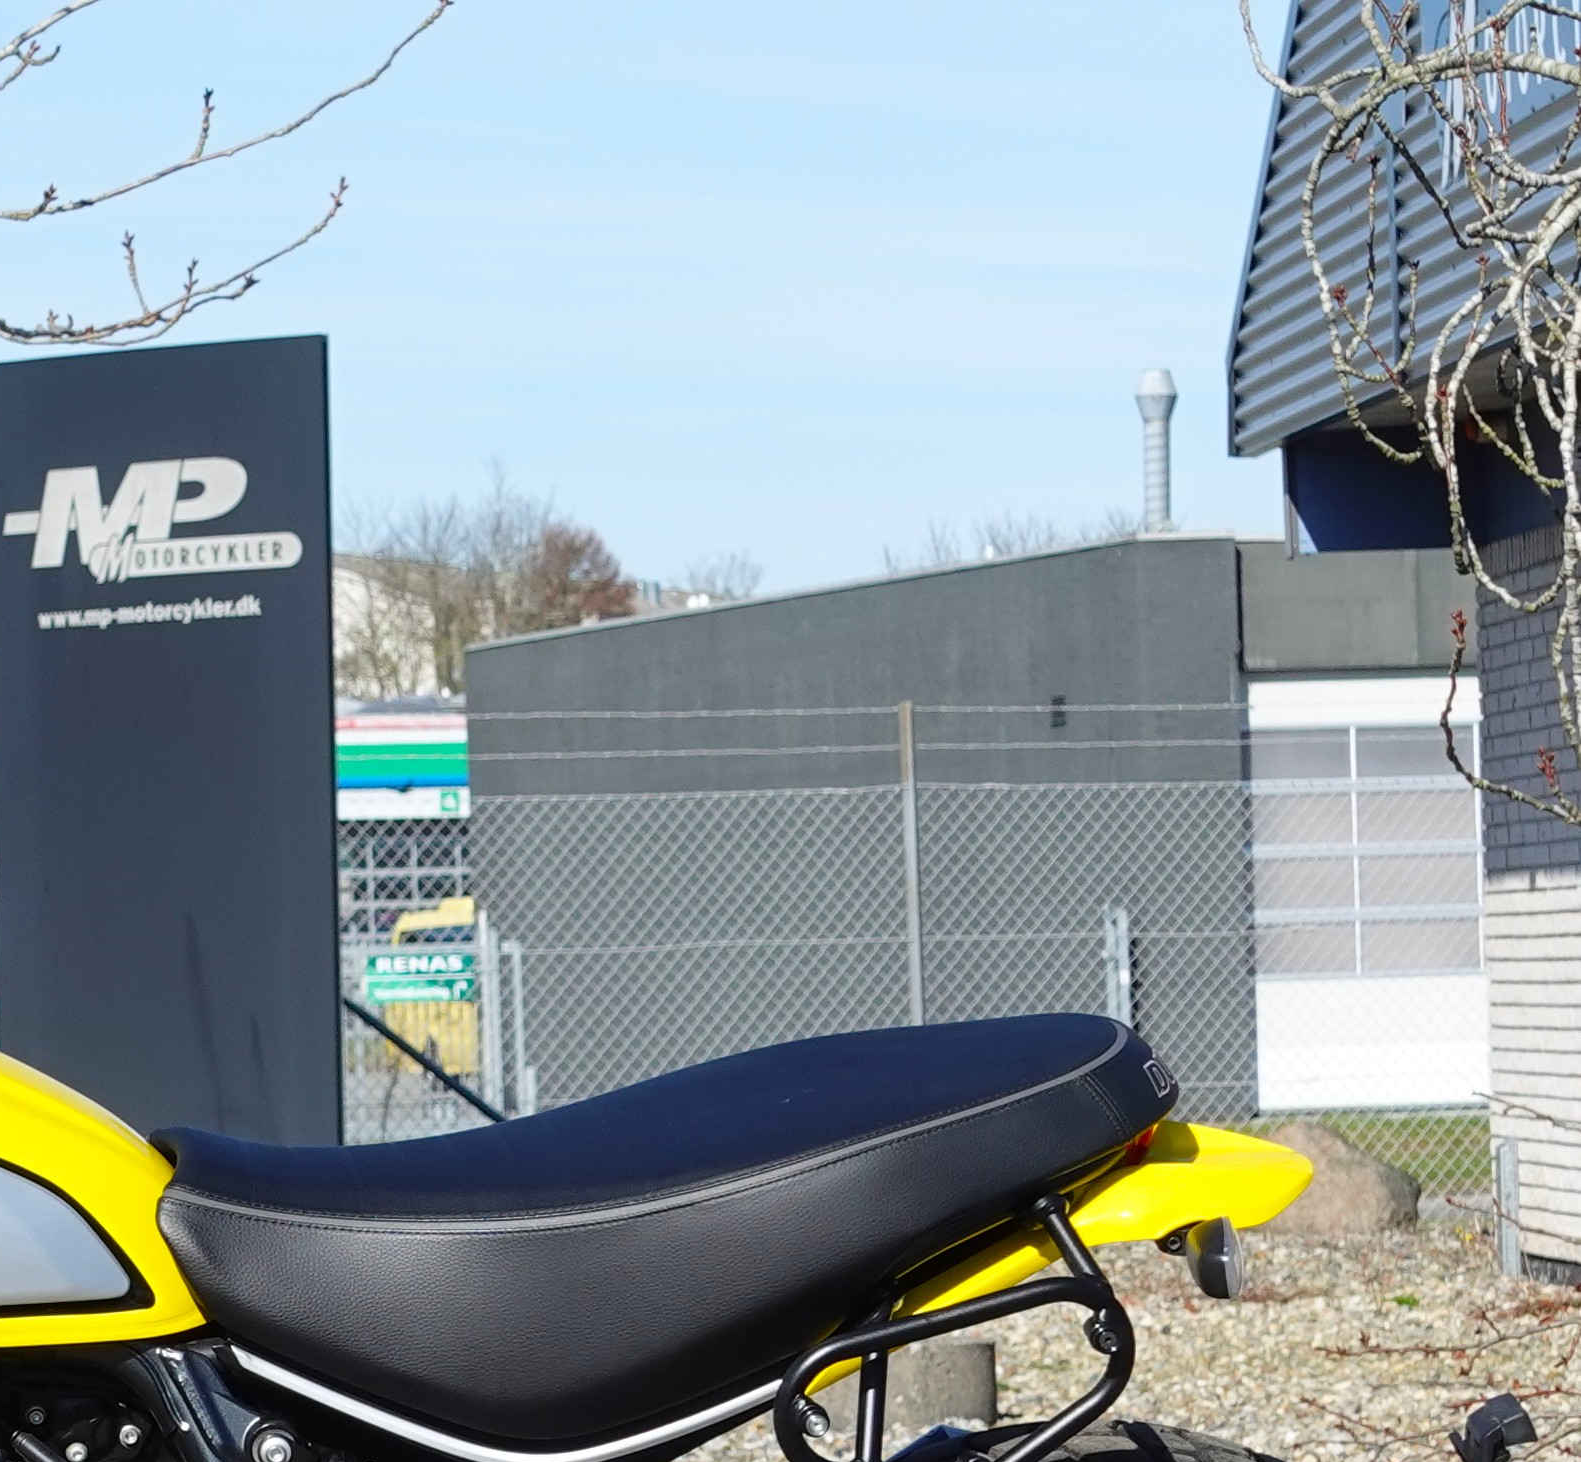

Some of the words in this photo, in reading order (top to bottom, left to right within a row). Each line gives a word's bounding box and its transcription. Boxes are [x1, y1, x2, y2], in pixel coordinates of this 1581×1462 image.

[3, 456, 248, 570] MP
[96, 531, 285, 585] MOTORCYKLER
[37, 594, 262, 630] www.mp-motorcykler.dk
[375, 953, 464, 974] RENAS
